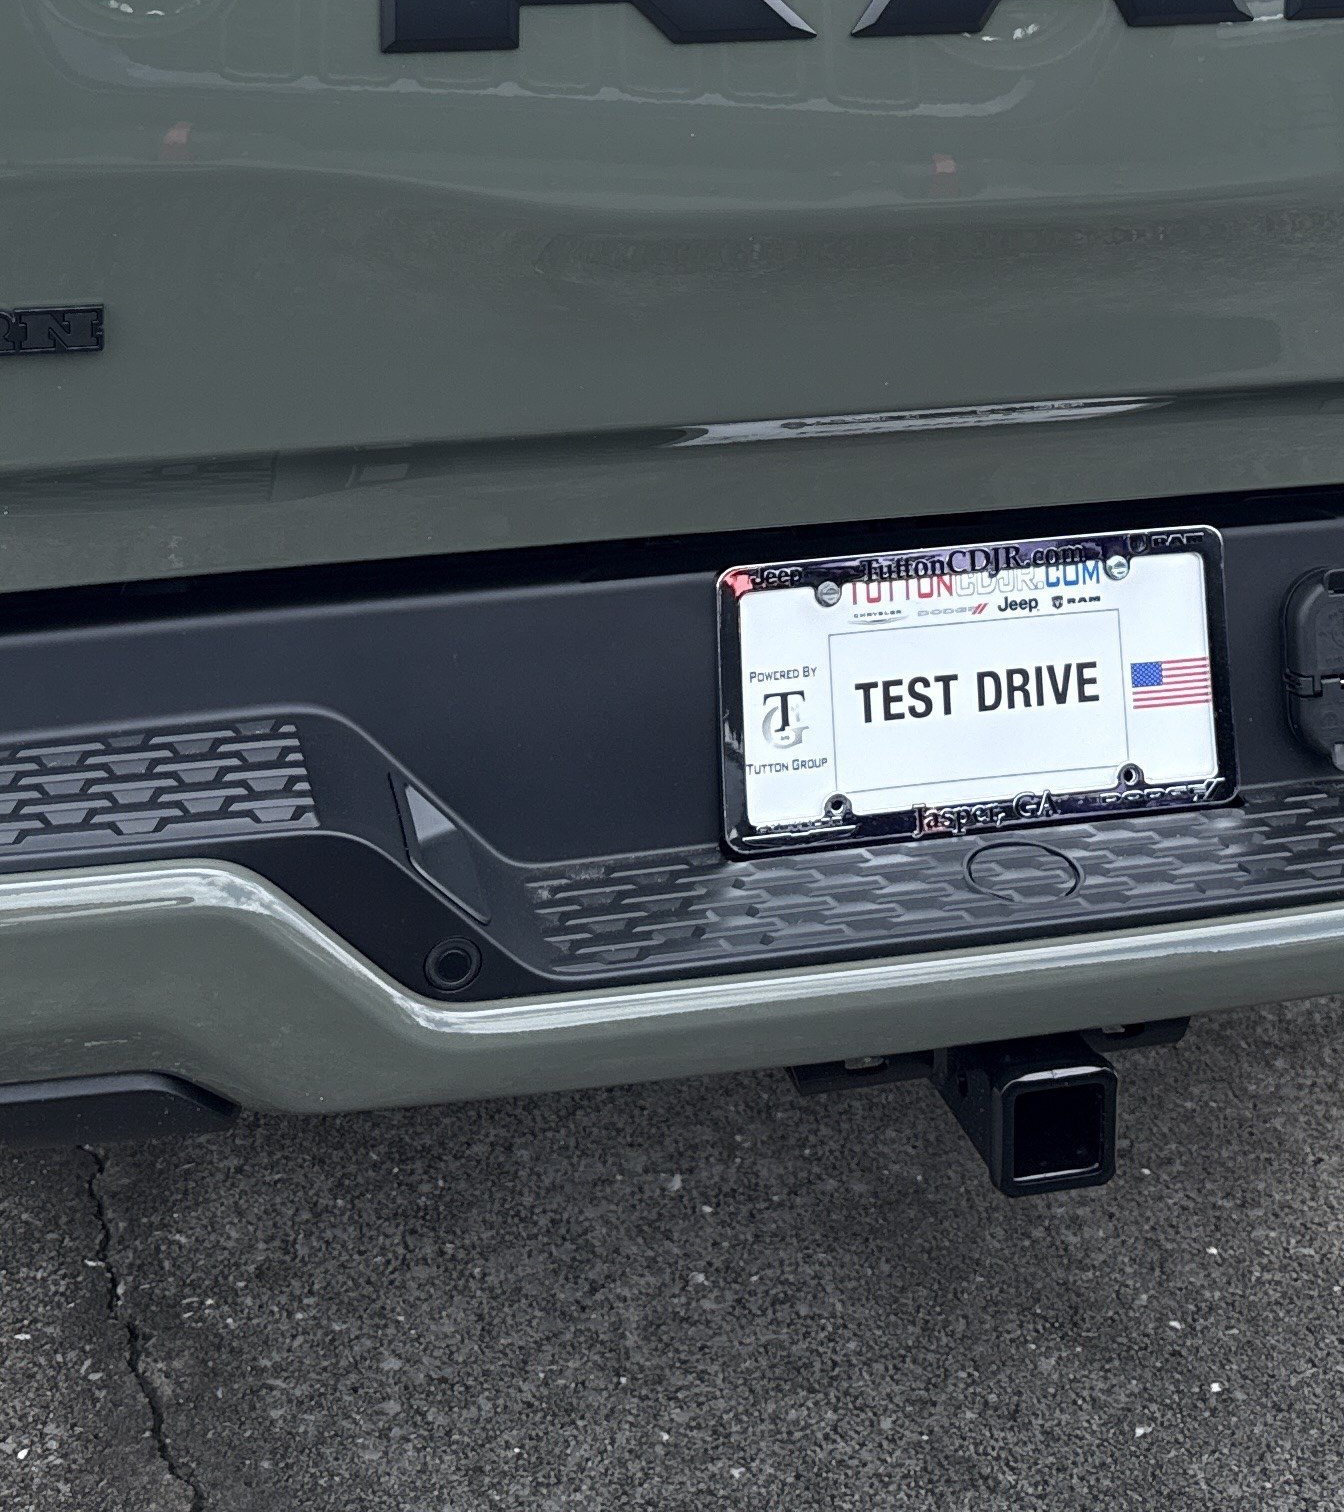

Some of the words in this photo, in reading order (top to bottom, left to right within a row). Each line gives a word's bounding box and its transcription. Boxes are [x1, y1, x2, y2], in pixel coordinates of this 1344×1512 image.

[750, 566, 803, 586] Jeep
[997, 595, 1039, 613] Jeep
[1066, 595, 1101, 605] RAM
[854, 673, 958, 724] TEST
[977, 661, 1100, 713] DRIVE
[1012, 789, 1054, 819] GA
